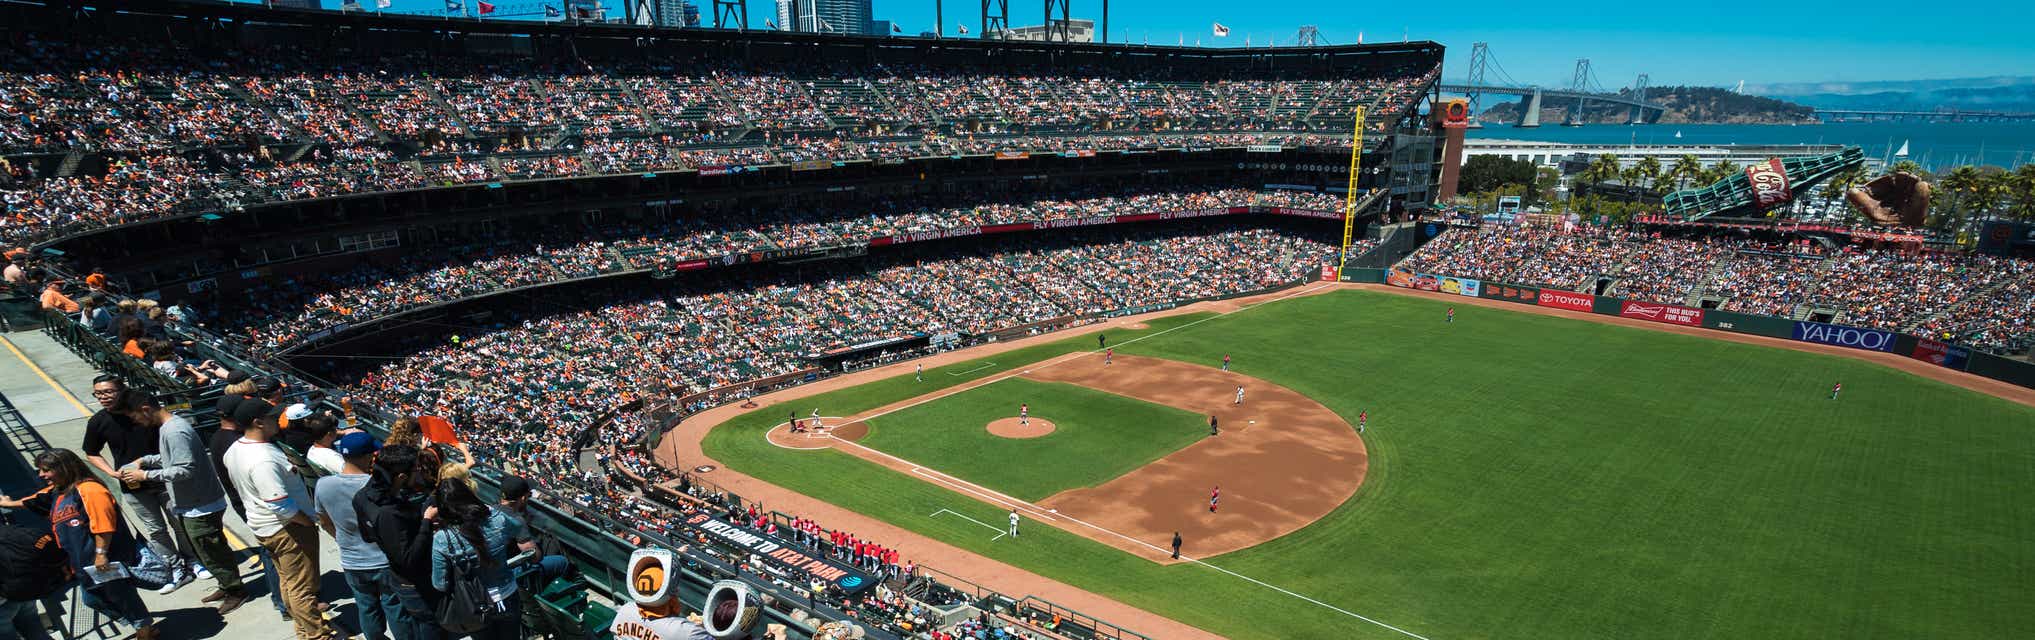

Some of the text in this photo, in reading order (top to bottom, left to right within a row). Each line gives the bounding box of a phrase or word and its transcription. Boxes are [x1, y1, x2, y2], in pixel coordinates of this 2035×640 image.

[1173, 210, 1197, 218] VIRGIN
[1198, 208, 1230, 217] AMERICA
[1312, 211, 1341, 219] AMERICA
[1033, 216, 1117, 230] FLY VIRGIN AMERICA
[892, 226, 982, 244] FLY VIRGIN AMERICA
[1554, 295, 1592, 307] TOYOTA
[1664, 313, 1678, 321] FOR
[1666, 306, 1700, 317] THIS BUD'S
[1800, 322, 1891, 350] YAHOO!
[700, 519, 848, 581] WELCOME TO AT&T PARK
